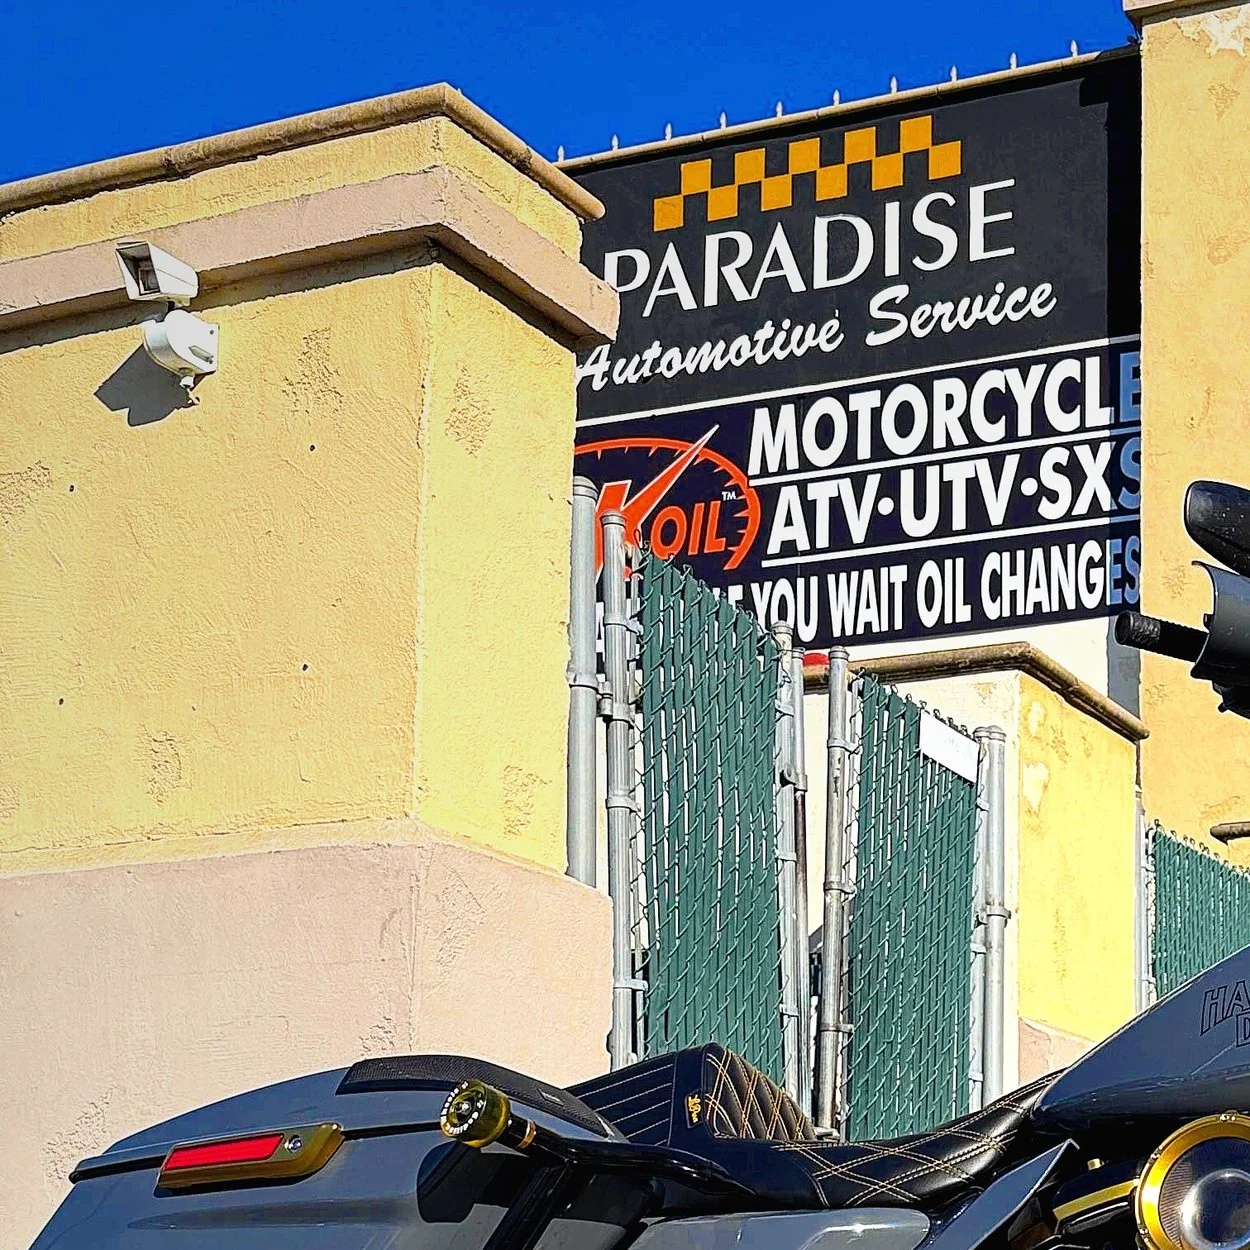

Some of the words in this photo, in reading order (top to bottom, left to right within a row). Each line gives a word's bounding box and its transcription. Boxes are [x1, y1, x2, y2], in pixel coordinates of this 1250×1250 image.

[603, 178, 1015, 318] PARADISE
[575, 318, 844, 391] Automotive
[865, 282, 1057, 348] Service
[747, 351, 1140, 476] MOTORCYCLE
[650, 500, 727, 562] OIL
[750, 575, 818, 643] YOU
[827, 565, 908, 638] WAIT
[916, 554, 972, 629] OIL
[980, 535, 1140, 621] CHANGES
